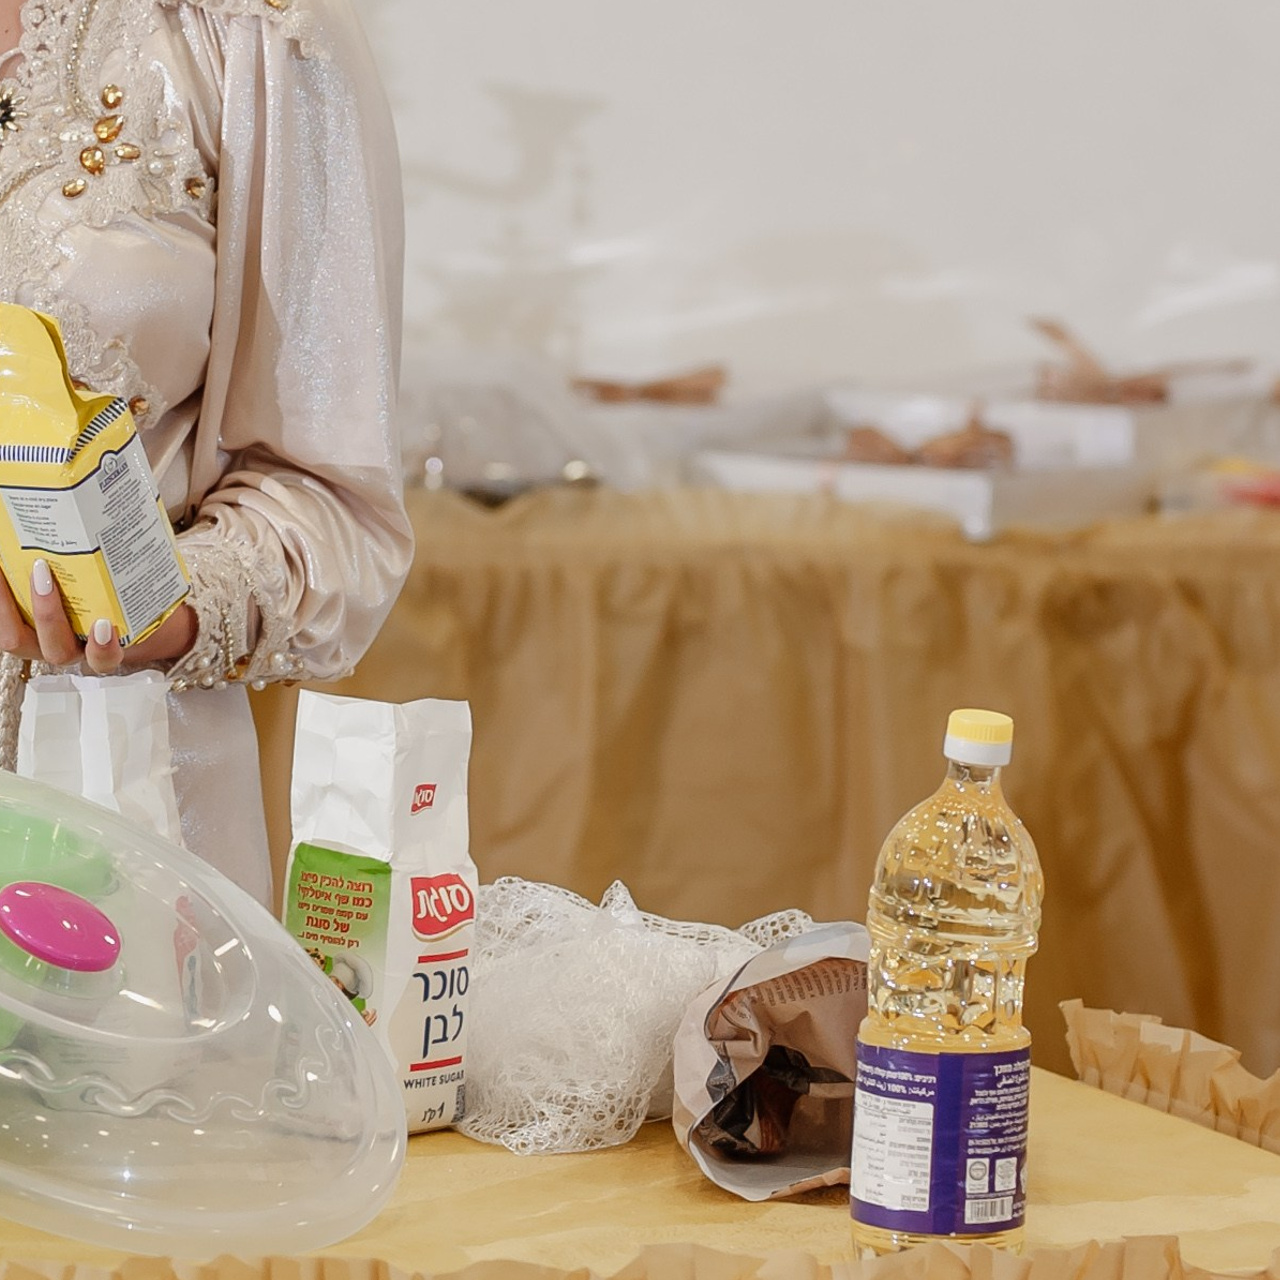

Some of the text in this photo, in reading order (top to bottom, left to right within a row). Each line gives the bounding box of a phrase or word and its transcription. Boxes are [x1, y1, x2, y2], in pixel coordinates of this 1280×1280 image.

[320, 873, 344, 888] להכין
[347, 880, 373, 893] רוצה
[334, 893, 350, 906] שף
[417, 883, 470, 922] סוגת
[333, 918, 350, 933] של
[412, 966, 469, 1002] סוכר
[423, 1004, 464, 1059] לבן
[404, 1075, 436, 1089] WHITE
